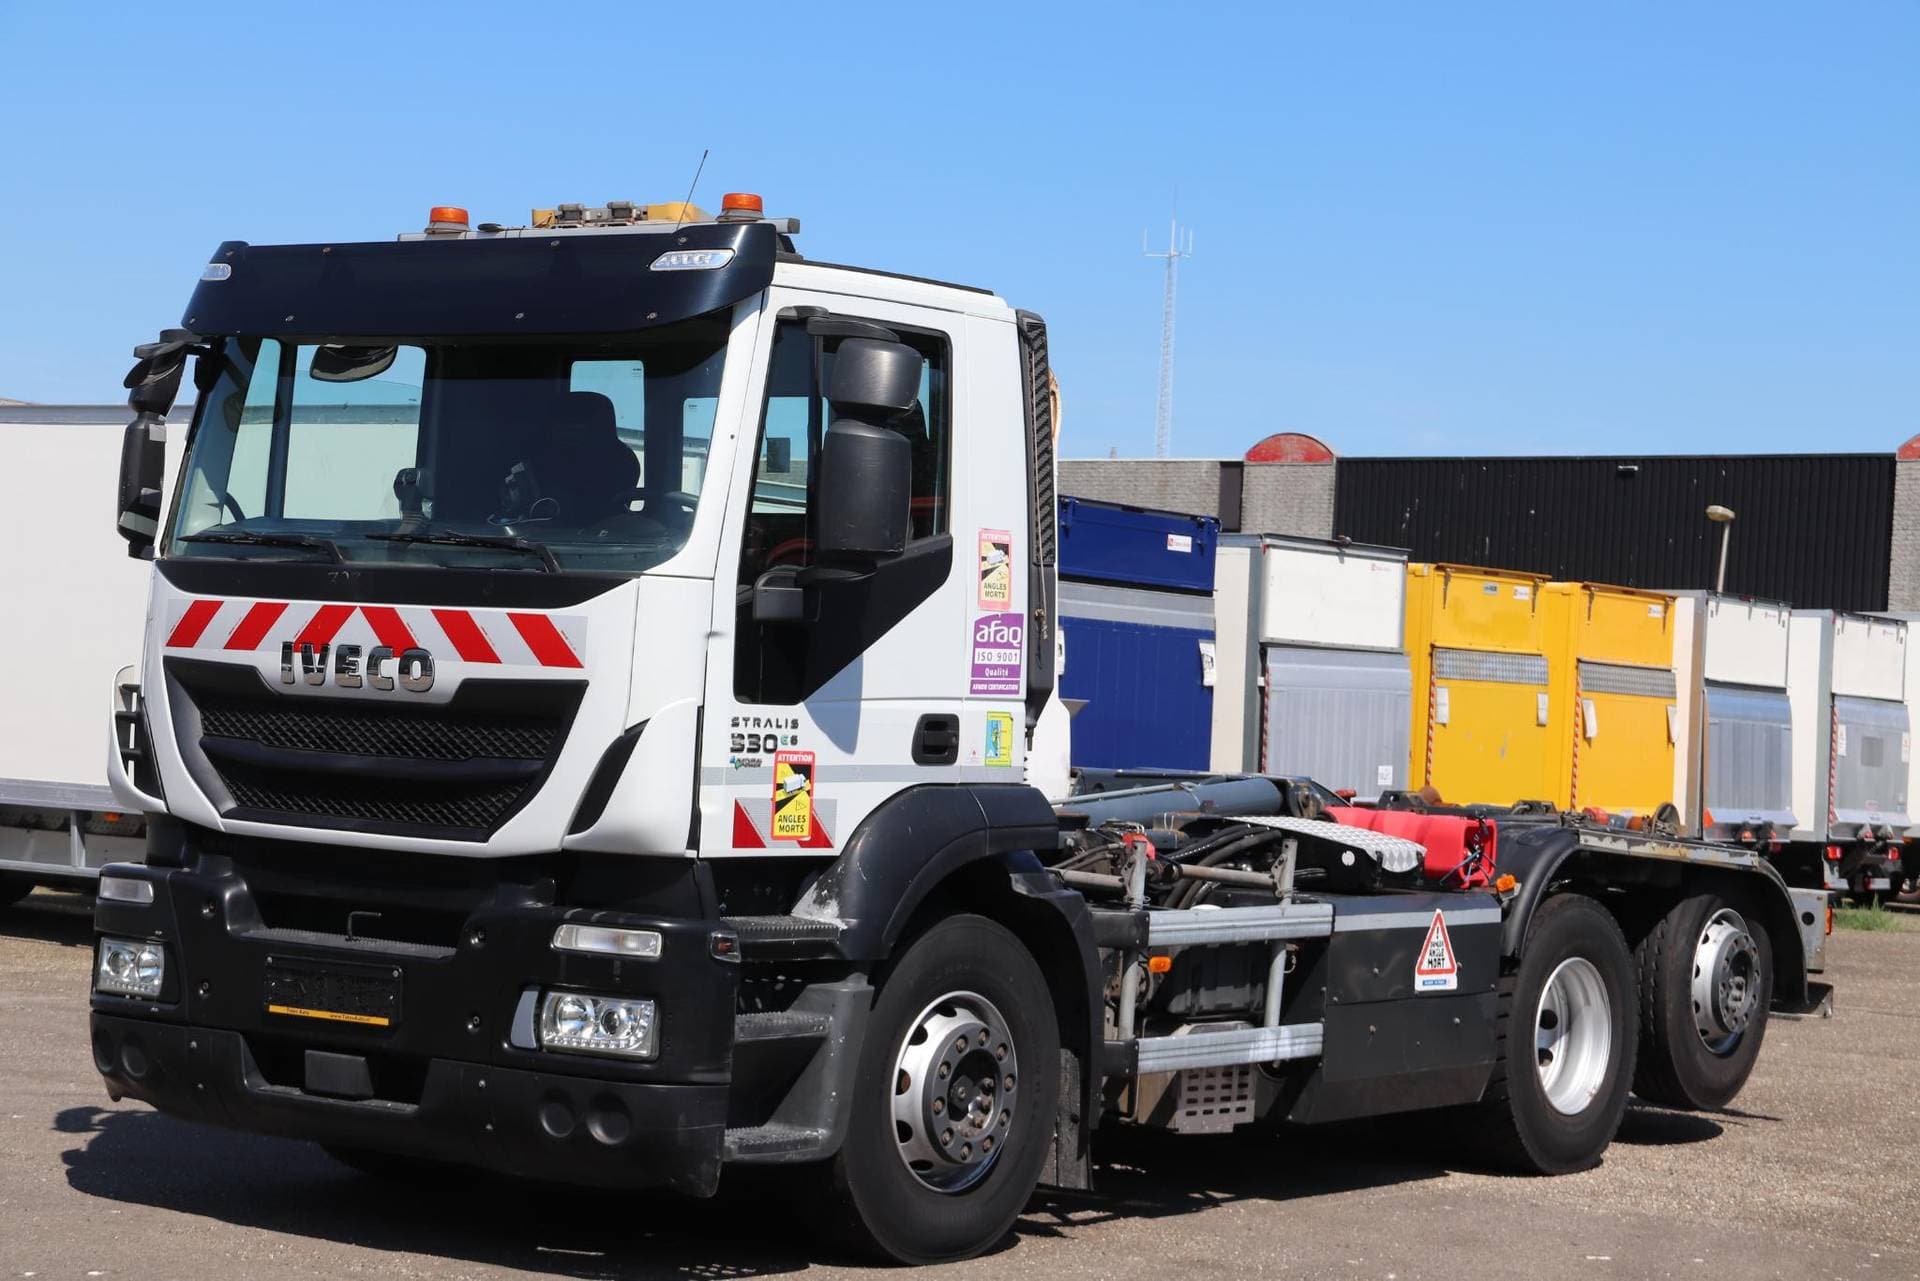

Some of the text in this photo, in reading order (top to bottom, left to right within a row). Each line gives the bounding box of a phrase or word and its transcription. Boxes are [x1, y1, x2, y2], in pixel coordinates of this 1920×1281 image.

[983, 582, 1007, 590] ANGLES
[984, 591, 1006, 599] MORTS
[975, 620, 1021, 647] afaq
[977, 652, 1018, 662] ISO 9001
[280, 641, 435, 692] IVECO
[730, 717, 799, 729] STRALIS
[777, 754, 814, 762] ATTENTION
[777, 814, 806, 823] ANGLES
[778, 824, 805, 833] MORTS
[1427, 958, 1445, 968] MORT
